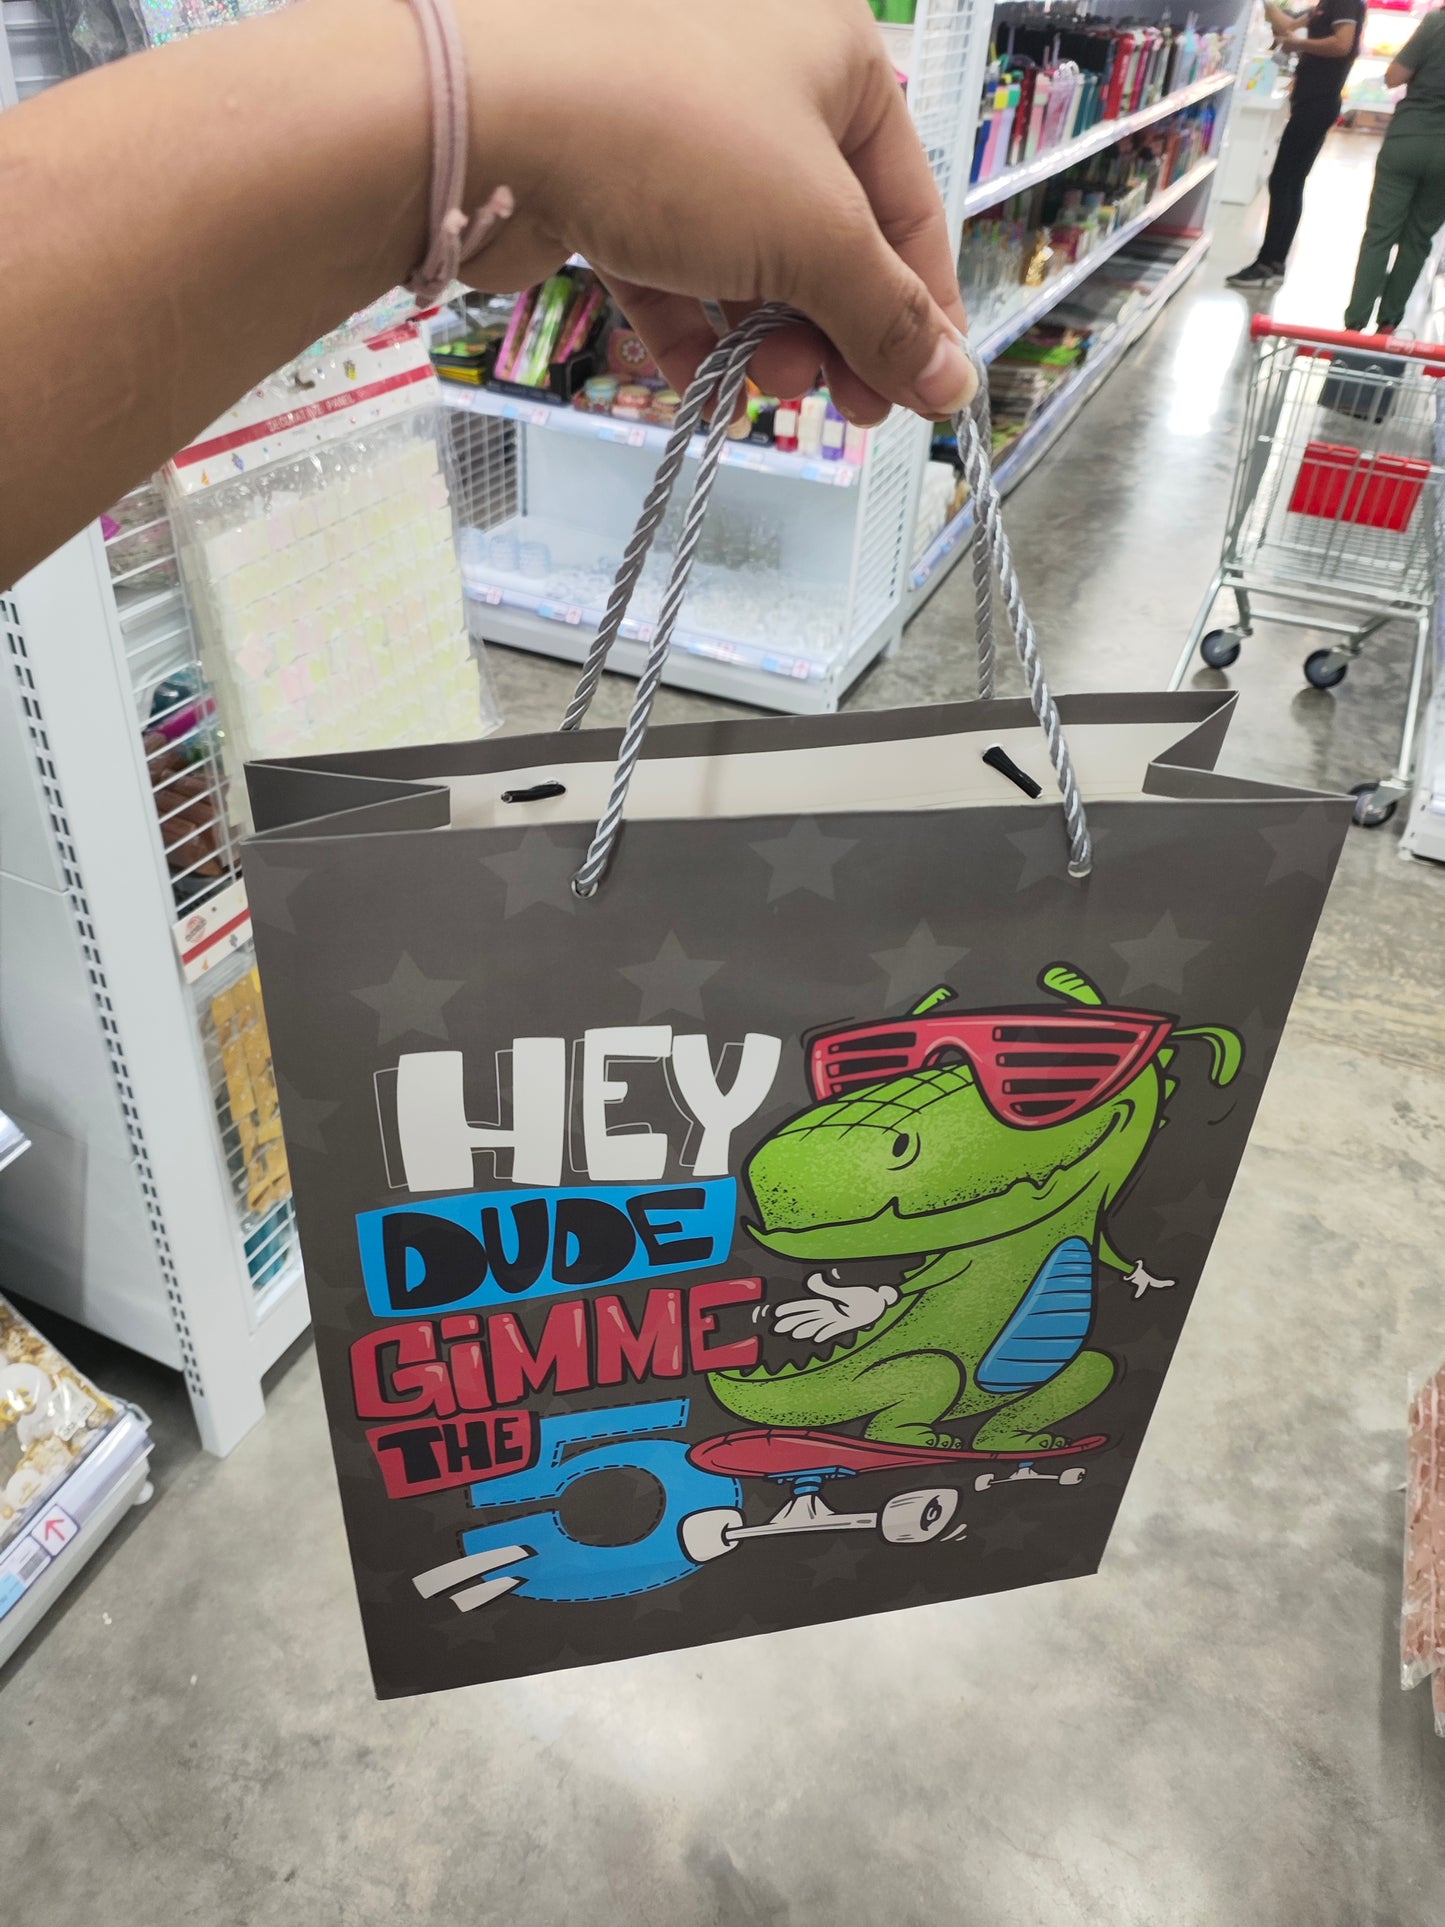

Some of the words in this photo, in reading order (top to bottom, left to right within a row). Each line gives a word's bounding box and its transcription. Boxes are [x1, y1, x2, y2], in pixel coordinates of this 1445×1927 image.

[374, 1025, 782, 1192] HEY
[382, 1188, 714, 1311] DUDE
[377, 1416, 524, 1484] THE
[458, 1396, 744, 1602] 5
